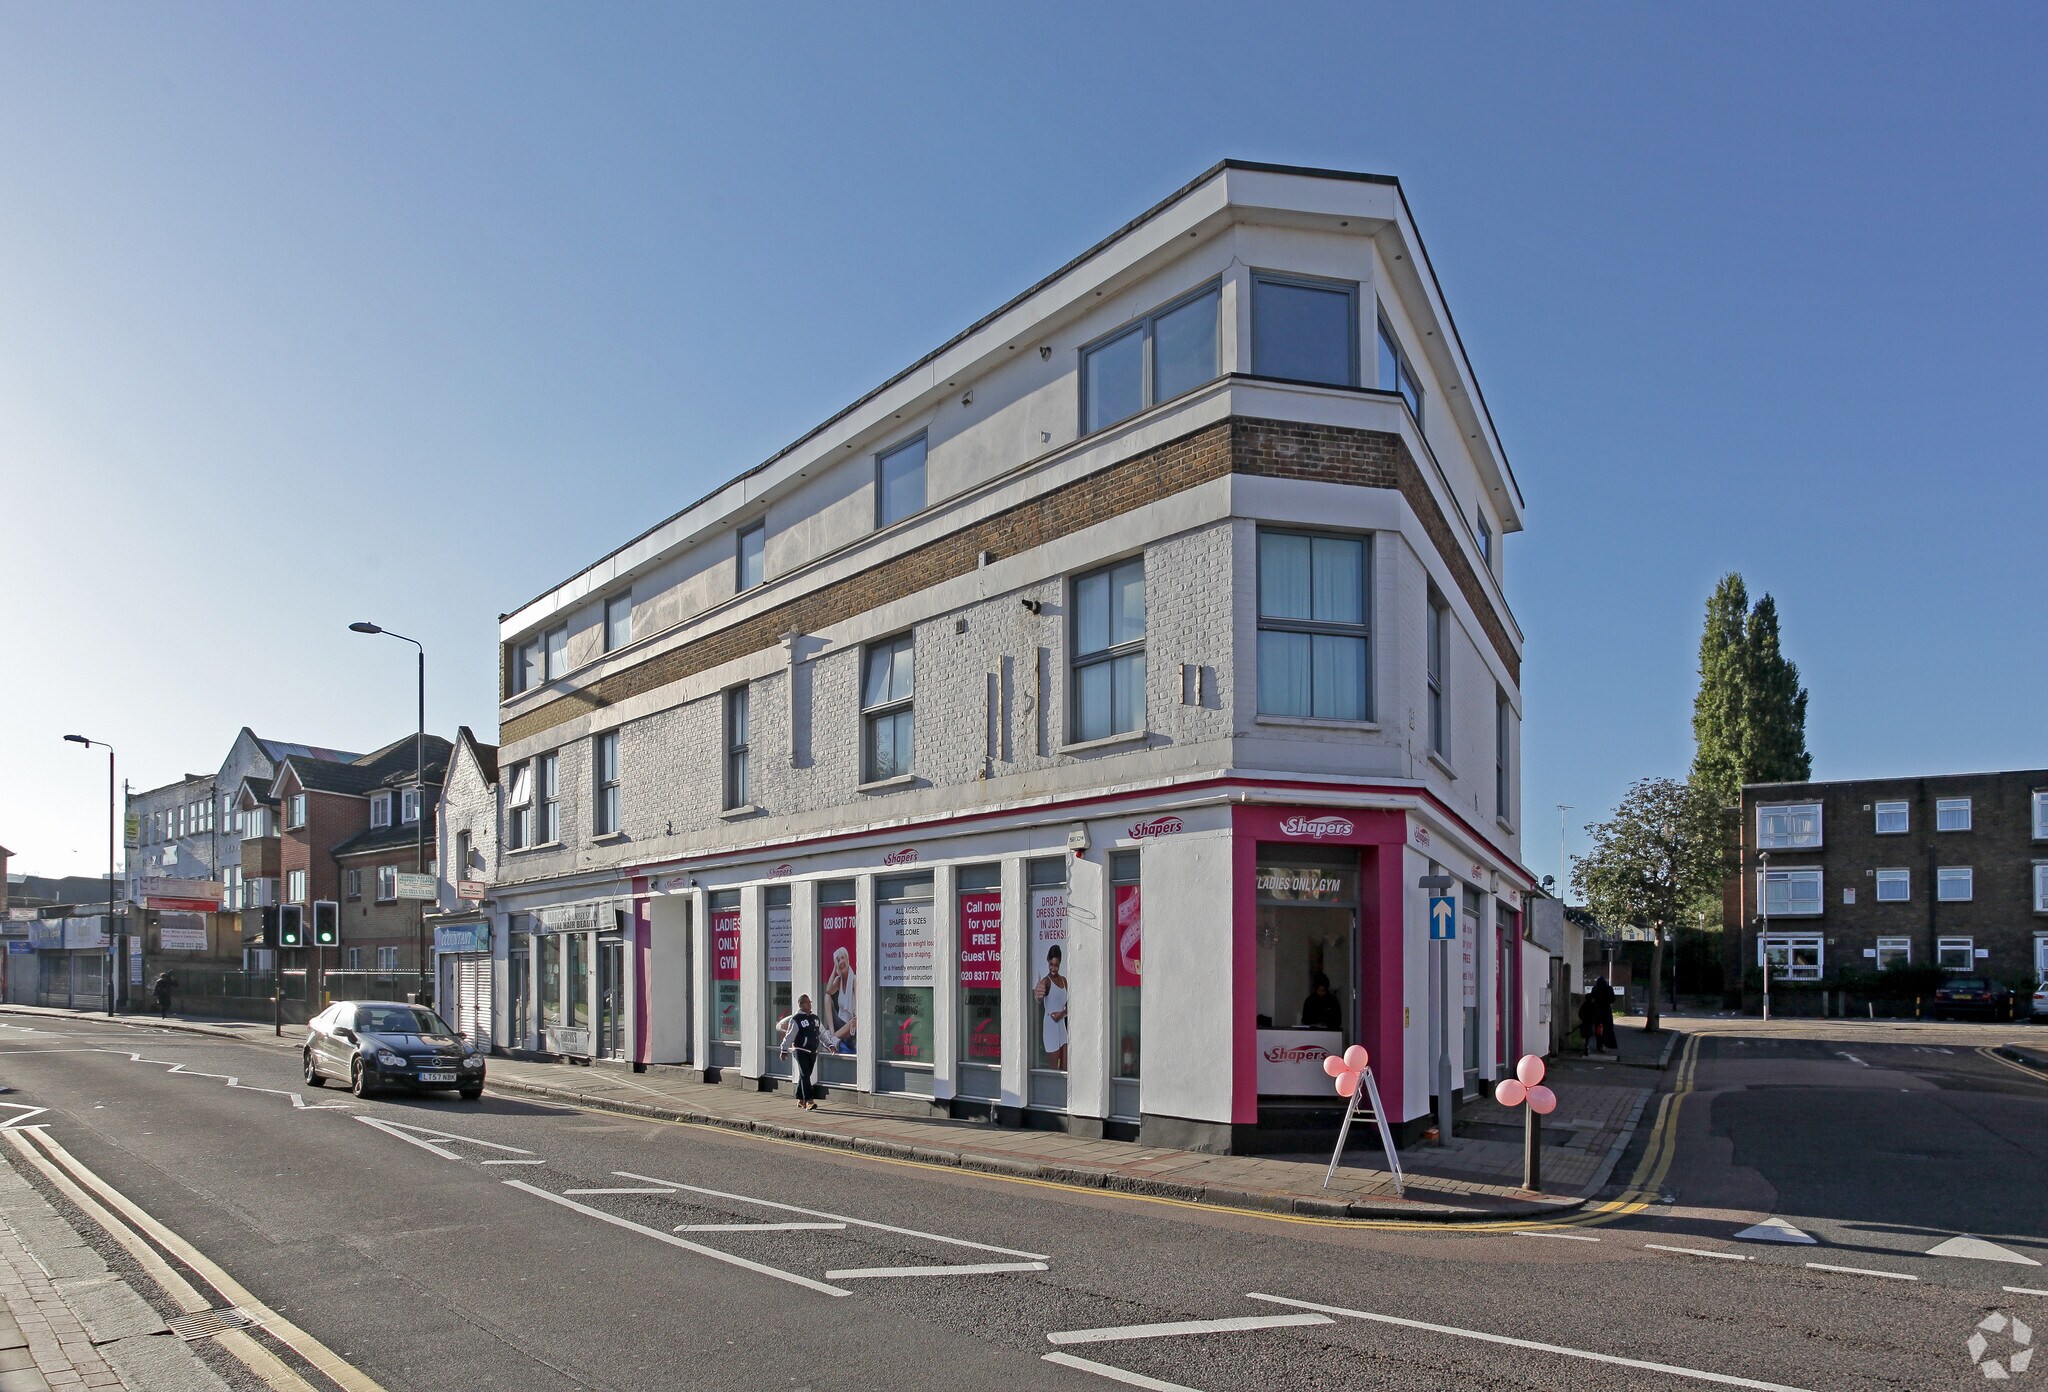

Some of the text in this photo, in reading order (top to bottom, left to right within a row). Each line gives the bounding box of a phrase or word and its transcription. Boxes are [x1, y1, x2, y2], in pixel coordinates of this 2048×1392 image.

[1132, 820, 1183, 838] Shapers
[1285, 816, 1352, 838] Shapers
[886, 852, 918, 865] Shapers
[768, 867, 793, 878] Shapers
[1257, 876, 1340, 892] LADIES ONLY GYM
[966, 902, 1000, 912] Call now
[1042, 896, 1063, 906] DROP A
[1036, 908, 1054, 918] DRESS
[563, 921, 575, 929] HAIR
[576, 920, 597, 928] BEAUTY
[716, 918, 741, 932] LADIES
[824, 918, 833, 929] 020
[834, 917, 848, 928] 8317
[968, 918, 1000, 931] for your
[1041, 919, 1062, 928] IN JUST
[972, 934, 996, 945] FREE
[1039, 930, 1066, 940] 6 WEEKS!
[718, 937, 739, 950] ONLY
[913, 940, 926, 948] weight
[962, 950, 985, 962] Guest
[720, 956, 737, 969] GYM
[961, 972, 972, 980] 020
[974, 972, 990, 980] 8317
[1269, 1047, 1328, 1063] Shapers
